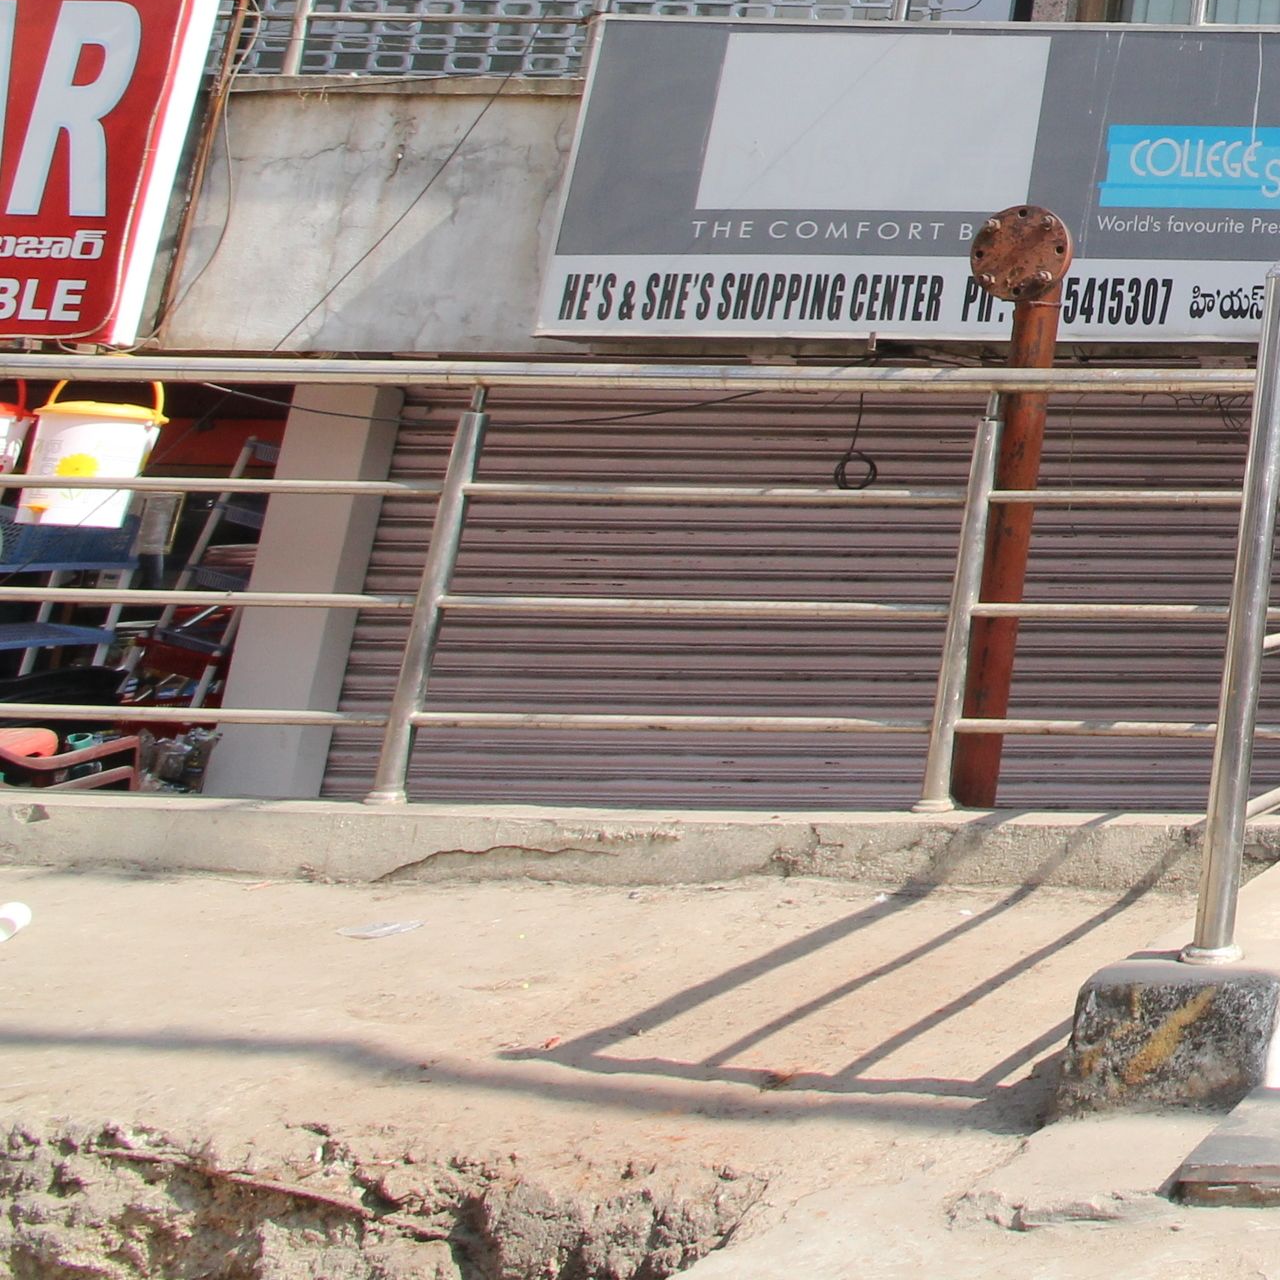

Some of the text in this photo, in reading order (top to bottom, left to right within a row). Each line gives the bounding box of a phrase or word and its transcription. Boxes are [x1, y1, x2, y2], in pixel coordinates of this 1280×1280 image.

[1129, 136, 1264, 179] COLLEGE
[692, 220, 754, 241] THE
[768, 220, 945, 241] COMFORT
[1097, 214, 1162, 234] World's
[1167, 214, 1245, 235] favourite
[558, 272, 617, 321] HE'S
[618, 280, 636, 320] &
[641, 272, 715, 321] SHE'S
[716, 272, 845, 322] SHOPPING
[848, 273, 945, 323] CENTER
